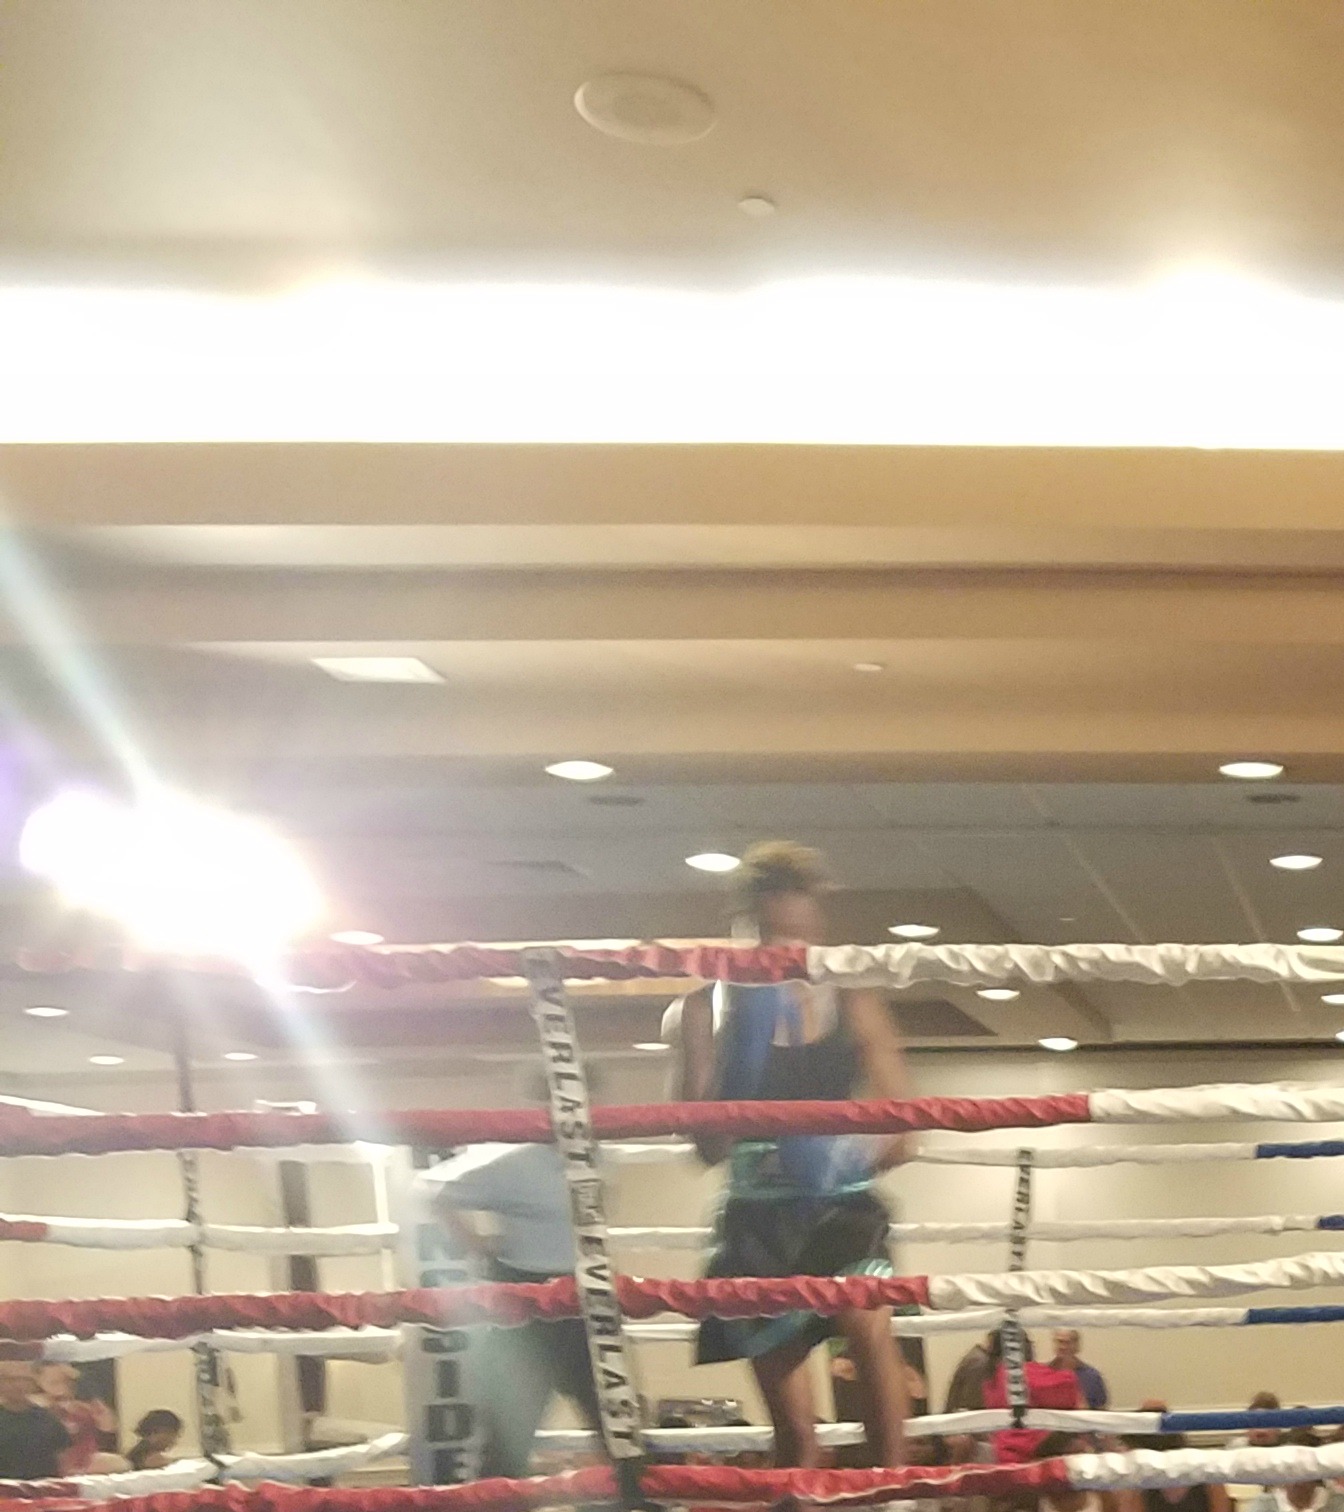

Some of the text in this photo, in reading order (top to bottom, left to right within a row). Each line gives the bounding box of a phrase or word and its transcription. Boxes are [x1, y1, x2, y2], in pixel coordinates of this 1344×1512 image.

[527, 957, 597, 1168] EVERLAST
[579, 1234, 637, 1442] EVERLAST
[1003, 1307, 1026, 1400] VERLAST
